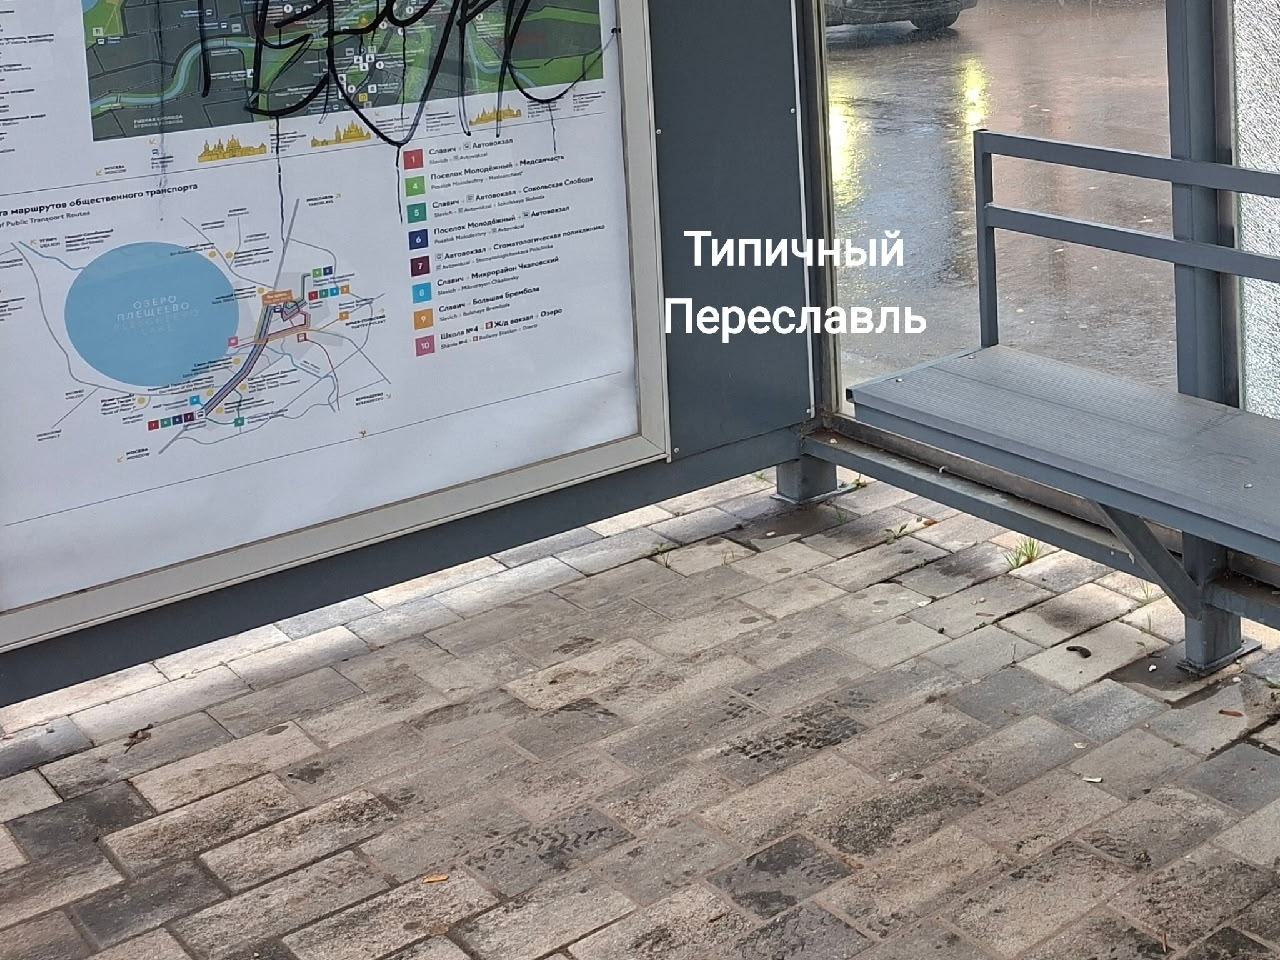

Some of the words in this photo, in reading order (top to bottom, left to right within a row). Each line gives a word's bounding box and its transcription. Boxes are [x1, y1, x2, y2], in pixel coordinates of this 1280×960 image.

[10, 202, 67, 216] маршрутов
[69, 191, 144, 207] общественного
[145, 183, 198, 198] транспорта
[6, 219, 29, 227] Public
